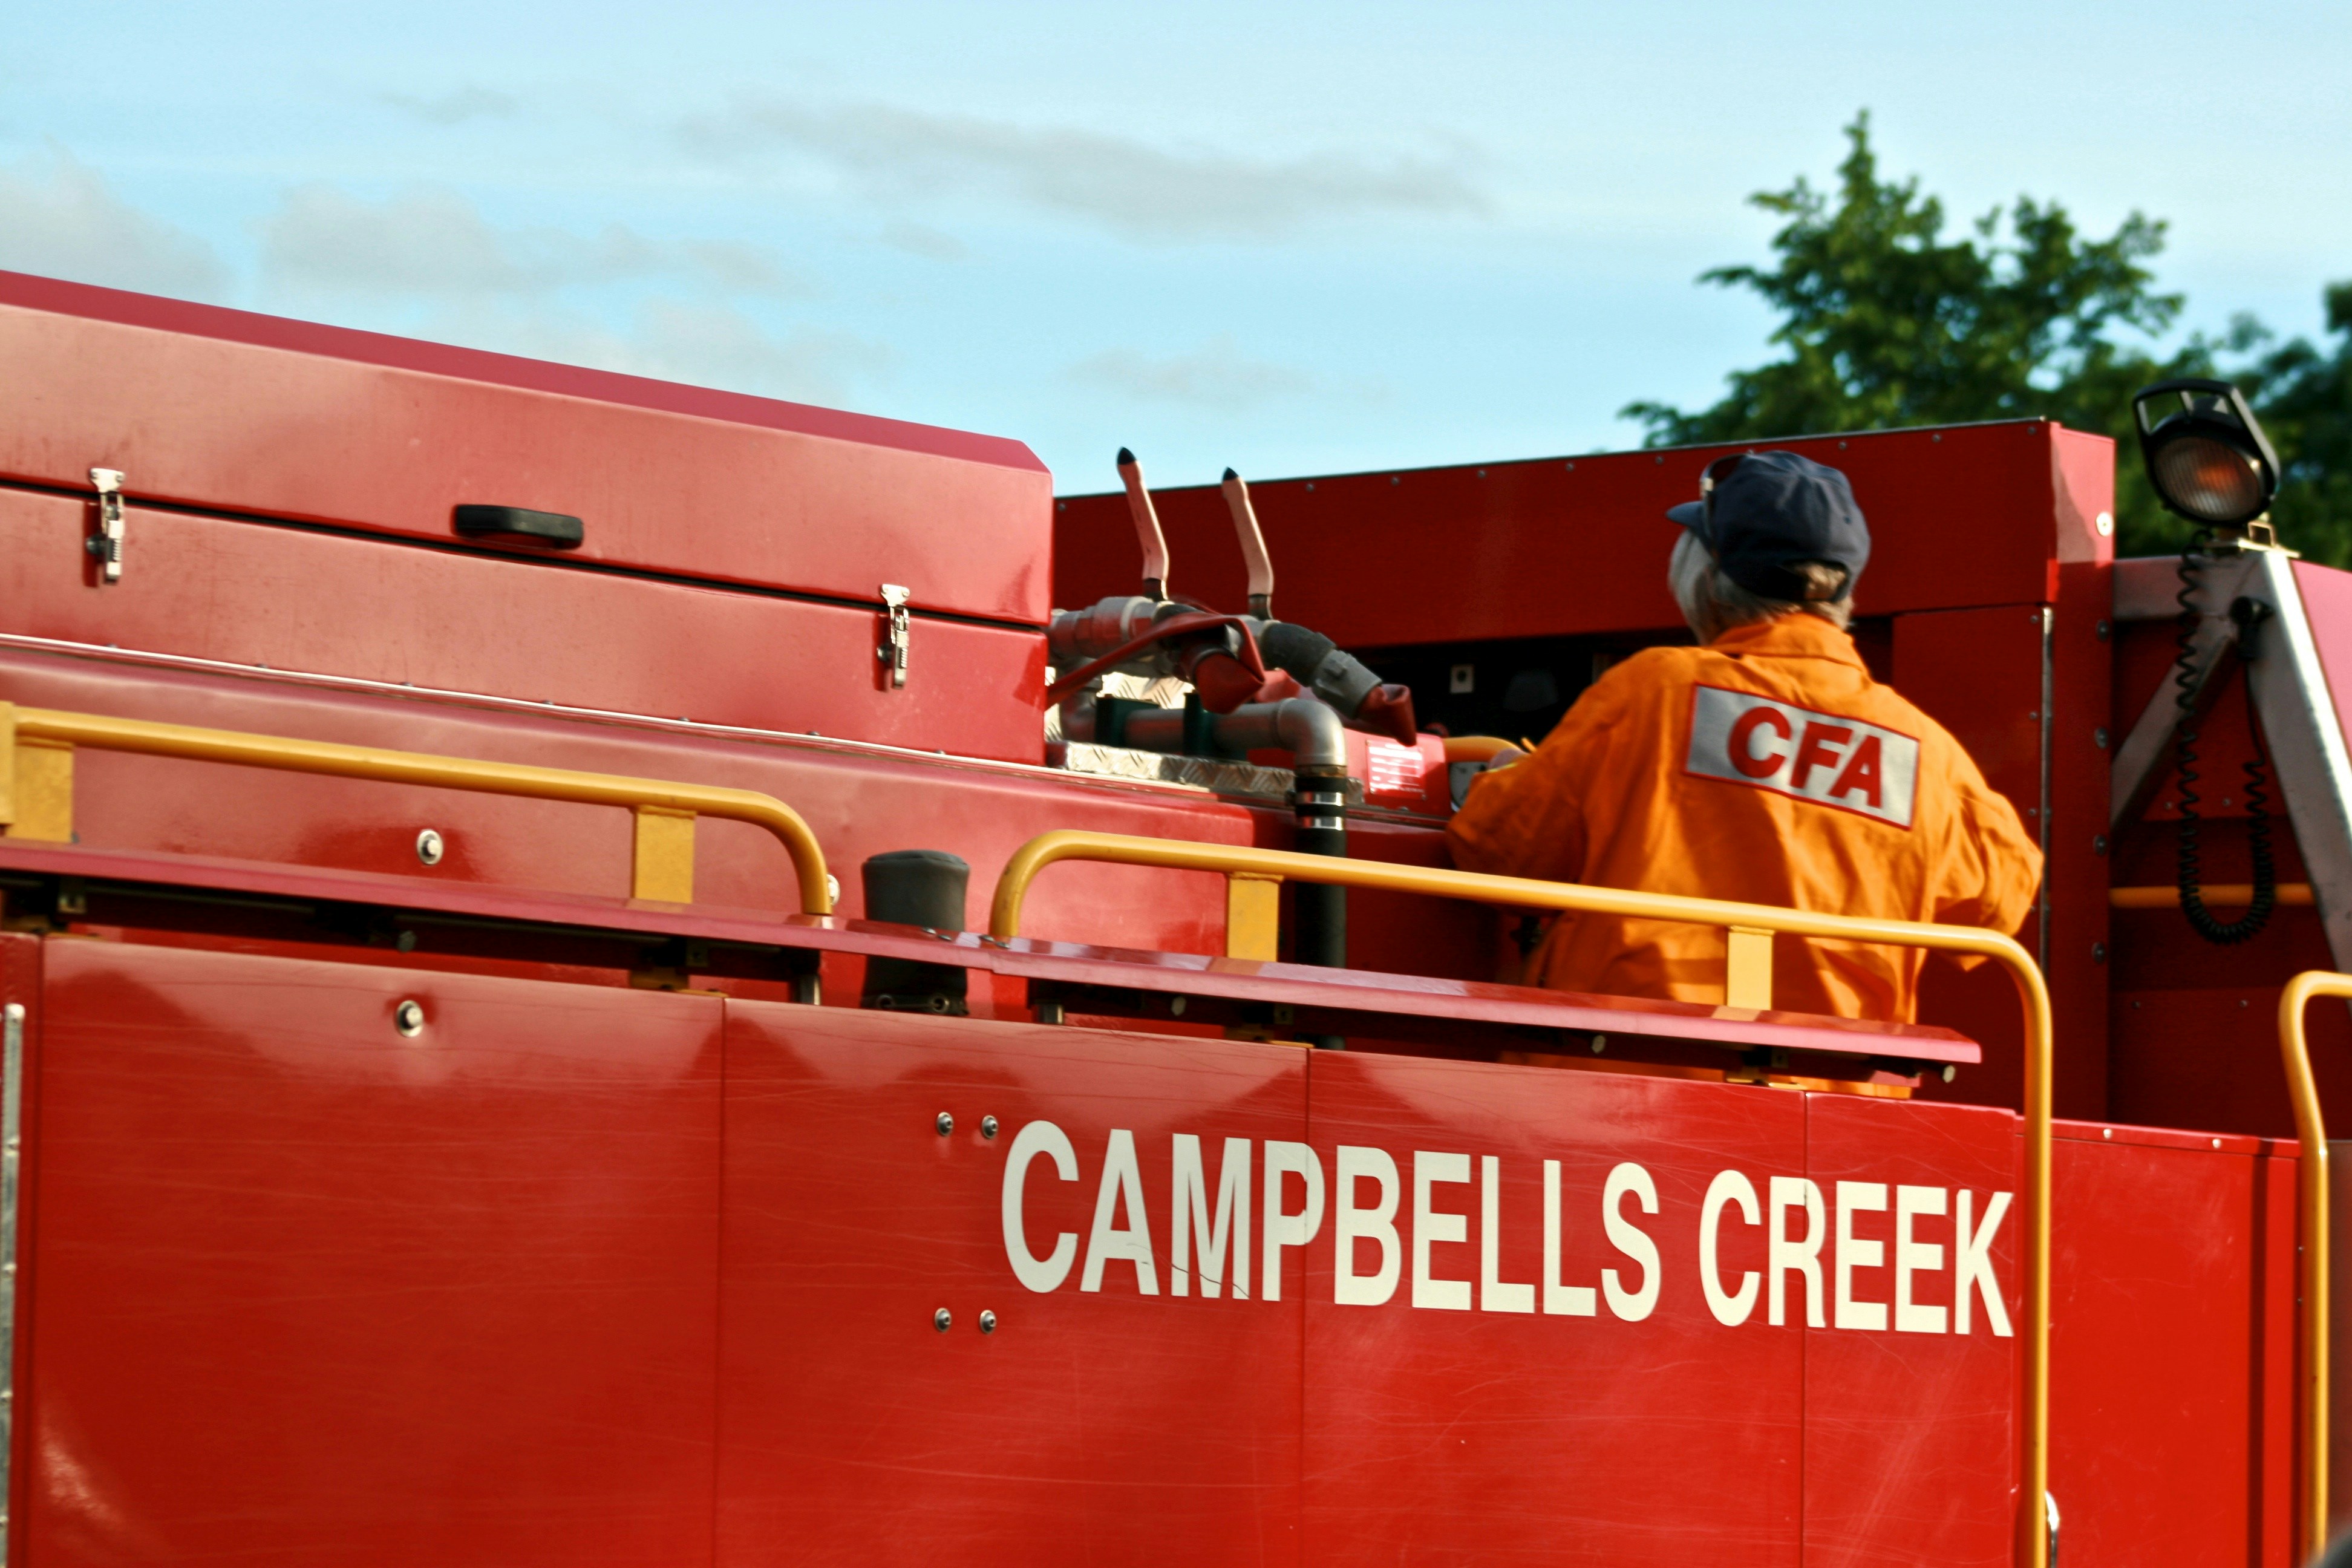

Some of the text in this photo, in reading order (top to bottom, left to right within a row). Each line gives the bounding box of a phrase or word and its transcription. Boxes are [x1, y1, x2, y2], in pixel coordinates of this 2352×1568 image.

[1727, 706, 1882, 809] CFA
[1002, 1120, 2013, 1337] CAMPBELLS CREEK
